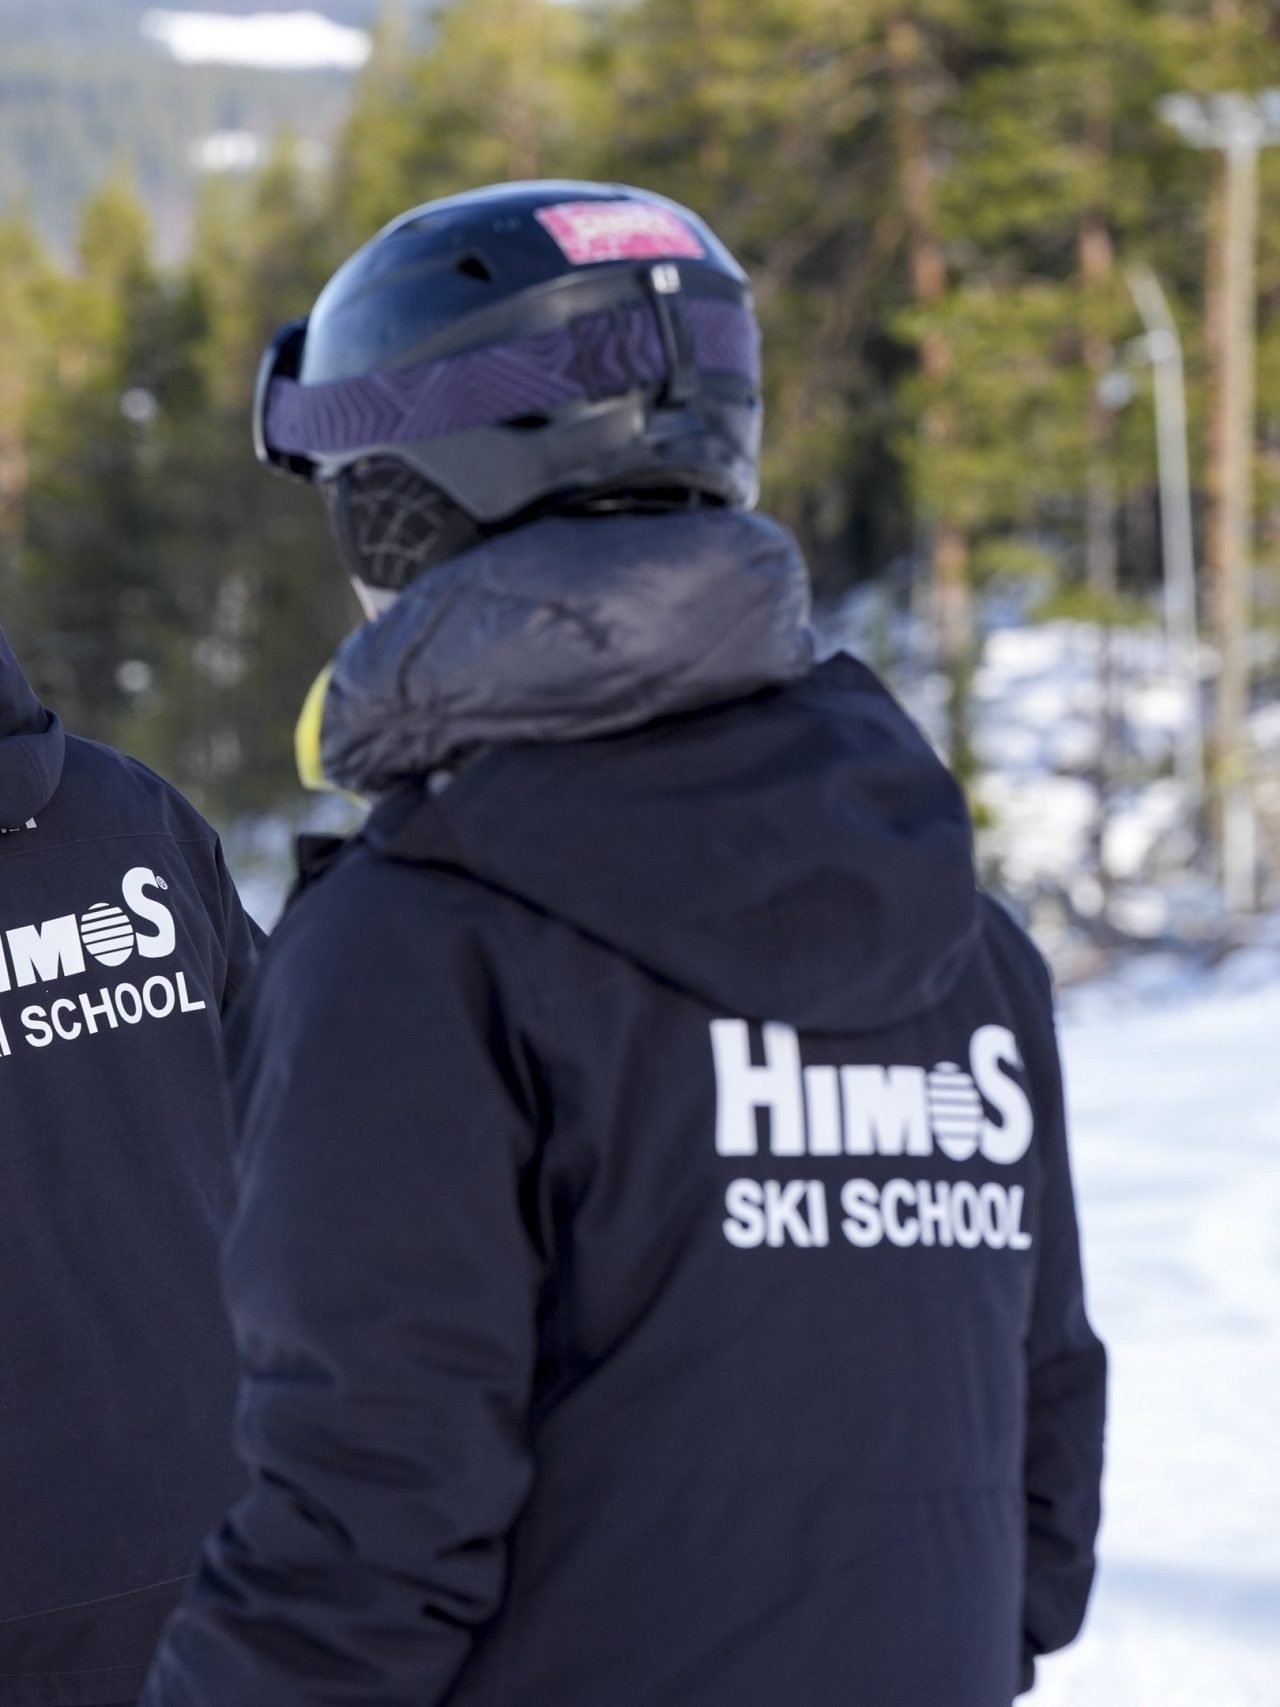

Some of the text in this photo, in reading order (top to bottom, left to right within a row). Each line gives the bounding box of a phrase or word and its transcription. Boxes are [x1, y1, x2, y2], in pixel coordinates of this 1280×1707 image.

[20, 971, 207, 1048] SCHOOL
[722, 1177, 1032, 1250] SKI SCHOOL
